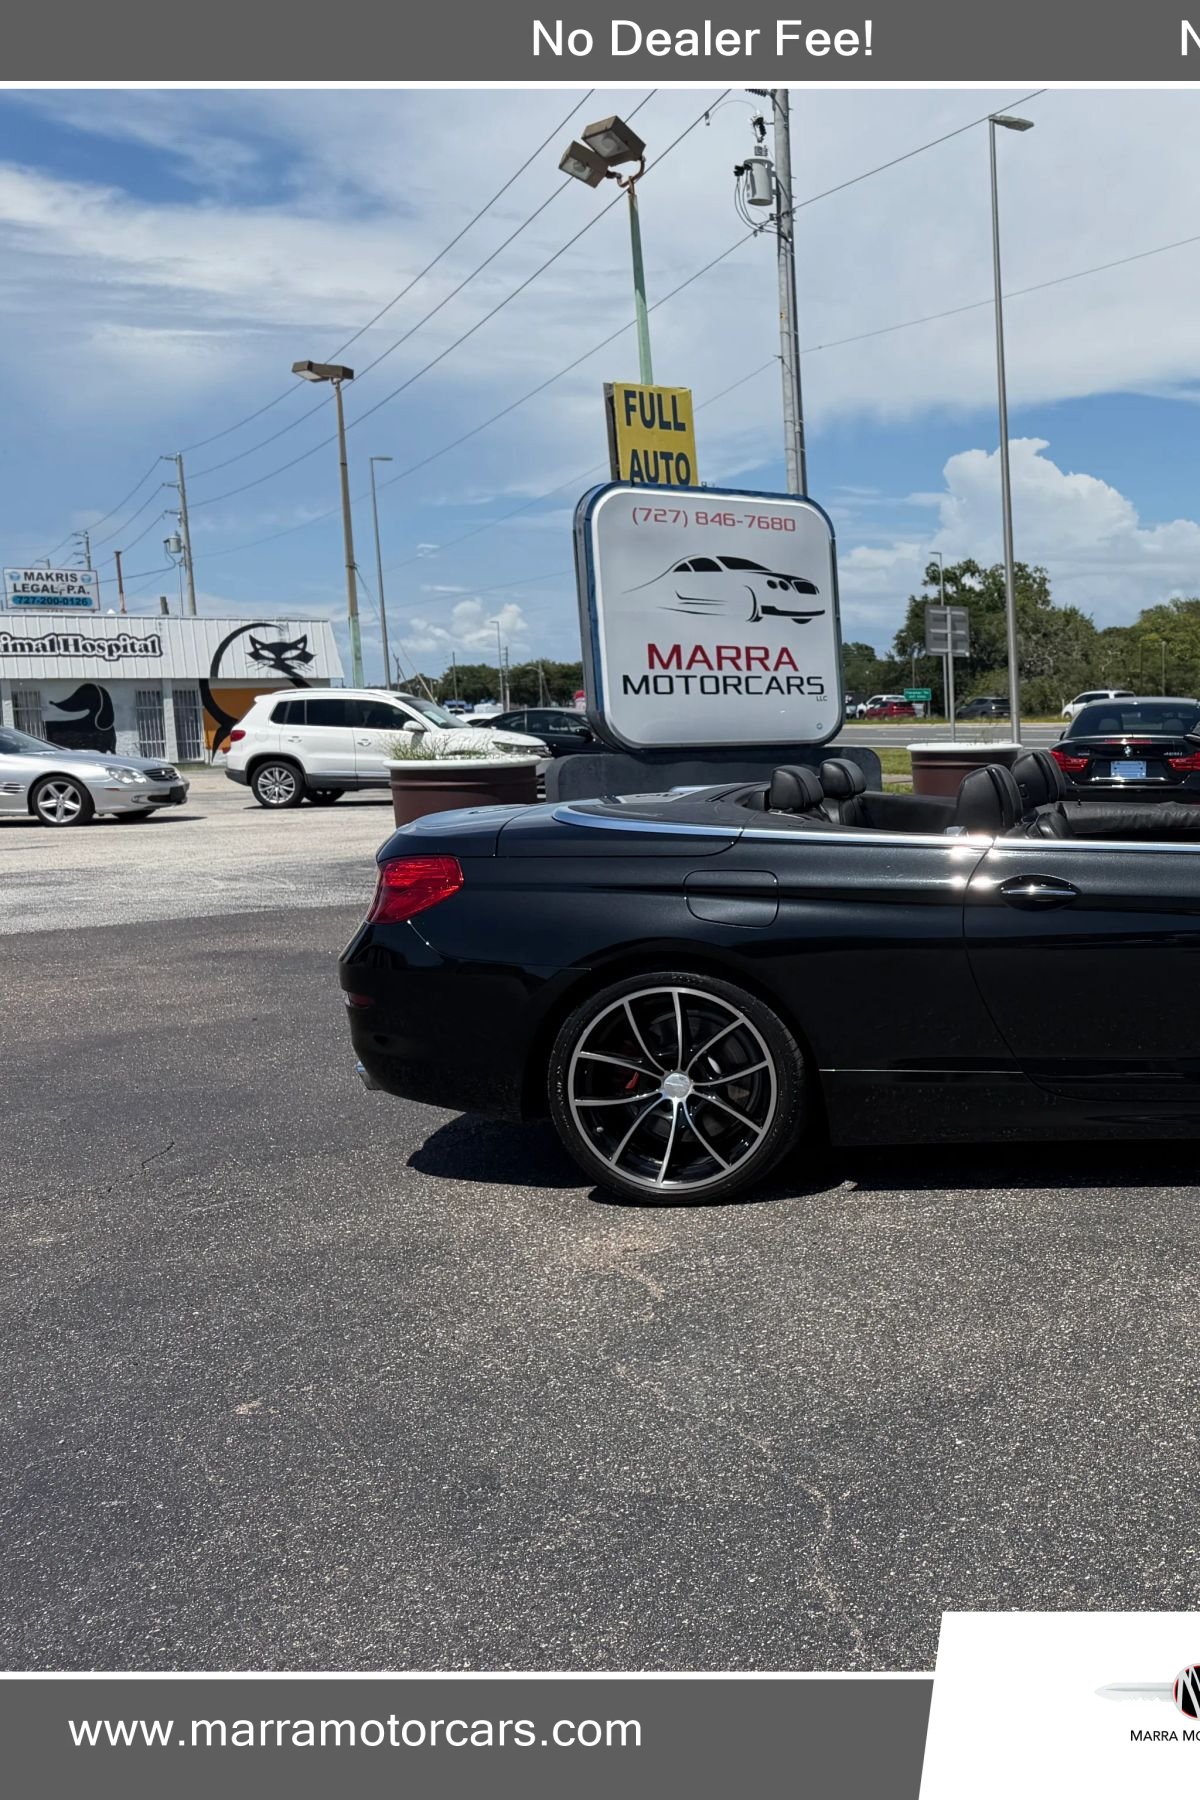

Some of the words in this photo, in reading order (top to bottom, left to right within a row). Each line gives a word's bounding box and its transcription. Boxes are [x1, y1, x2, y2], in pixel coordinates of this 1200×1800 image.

[623, 389, 686, 432] FULL
[629, 448, 691, 486] AUTO
[632, 507, 689, 528] (727)
[695, 511, 797, 532] 846-7680
[13, 583, 63, 595] LEGAL,
[66, 584, 91, 595] P.A.
[23, 571, 79, 583] MAKRIS
[16, 595, 89, 606] 727-200-0126
[59, 634, 161, 660] Hospital
[647, 643, 799, 672] MARRA
[622, 674, 825, 696] MOTORCARS
